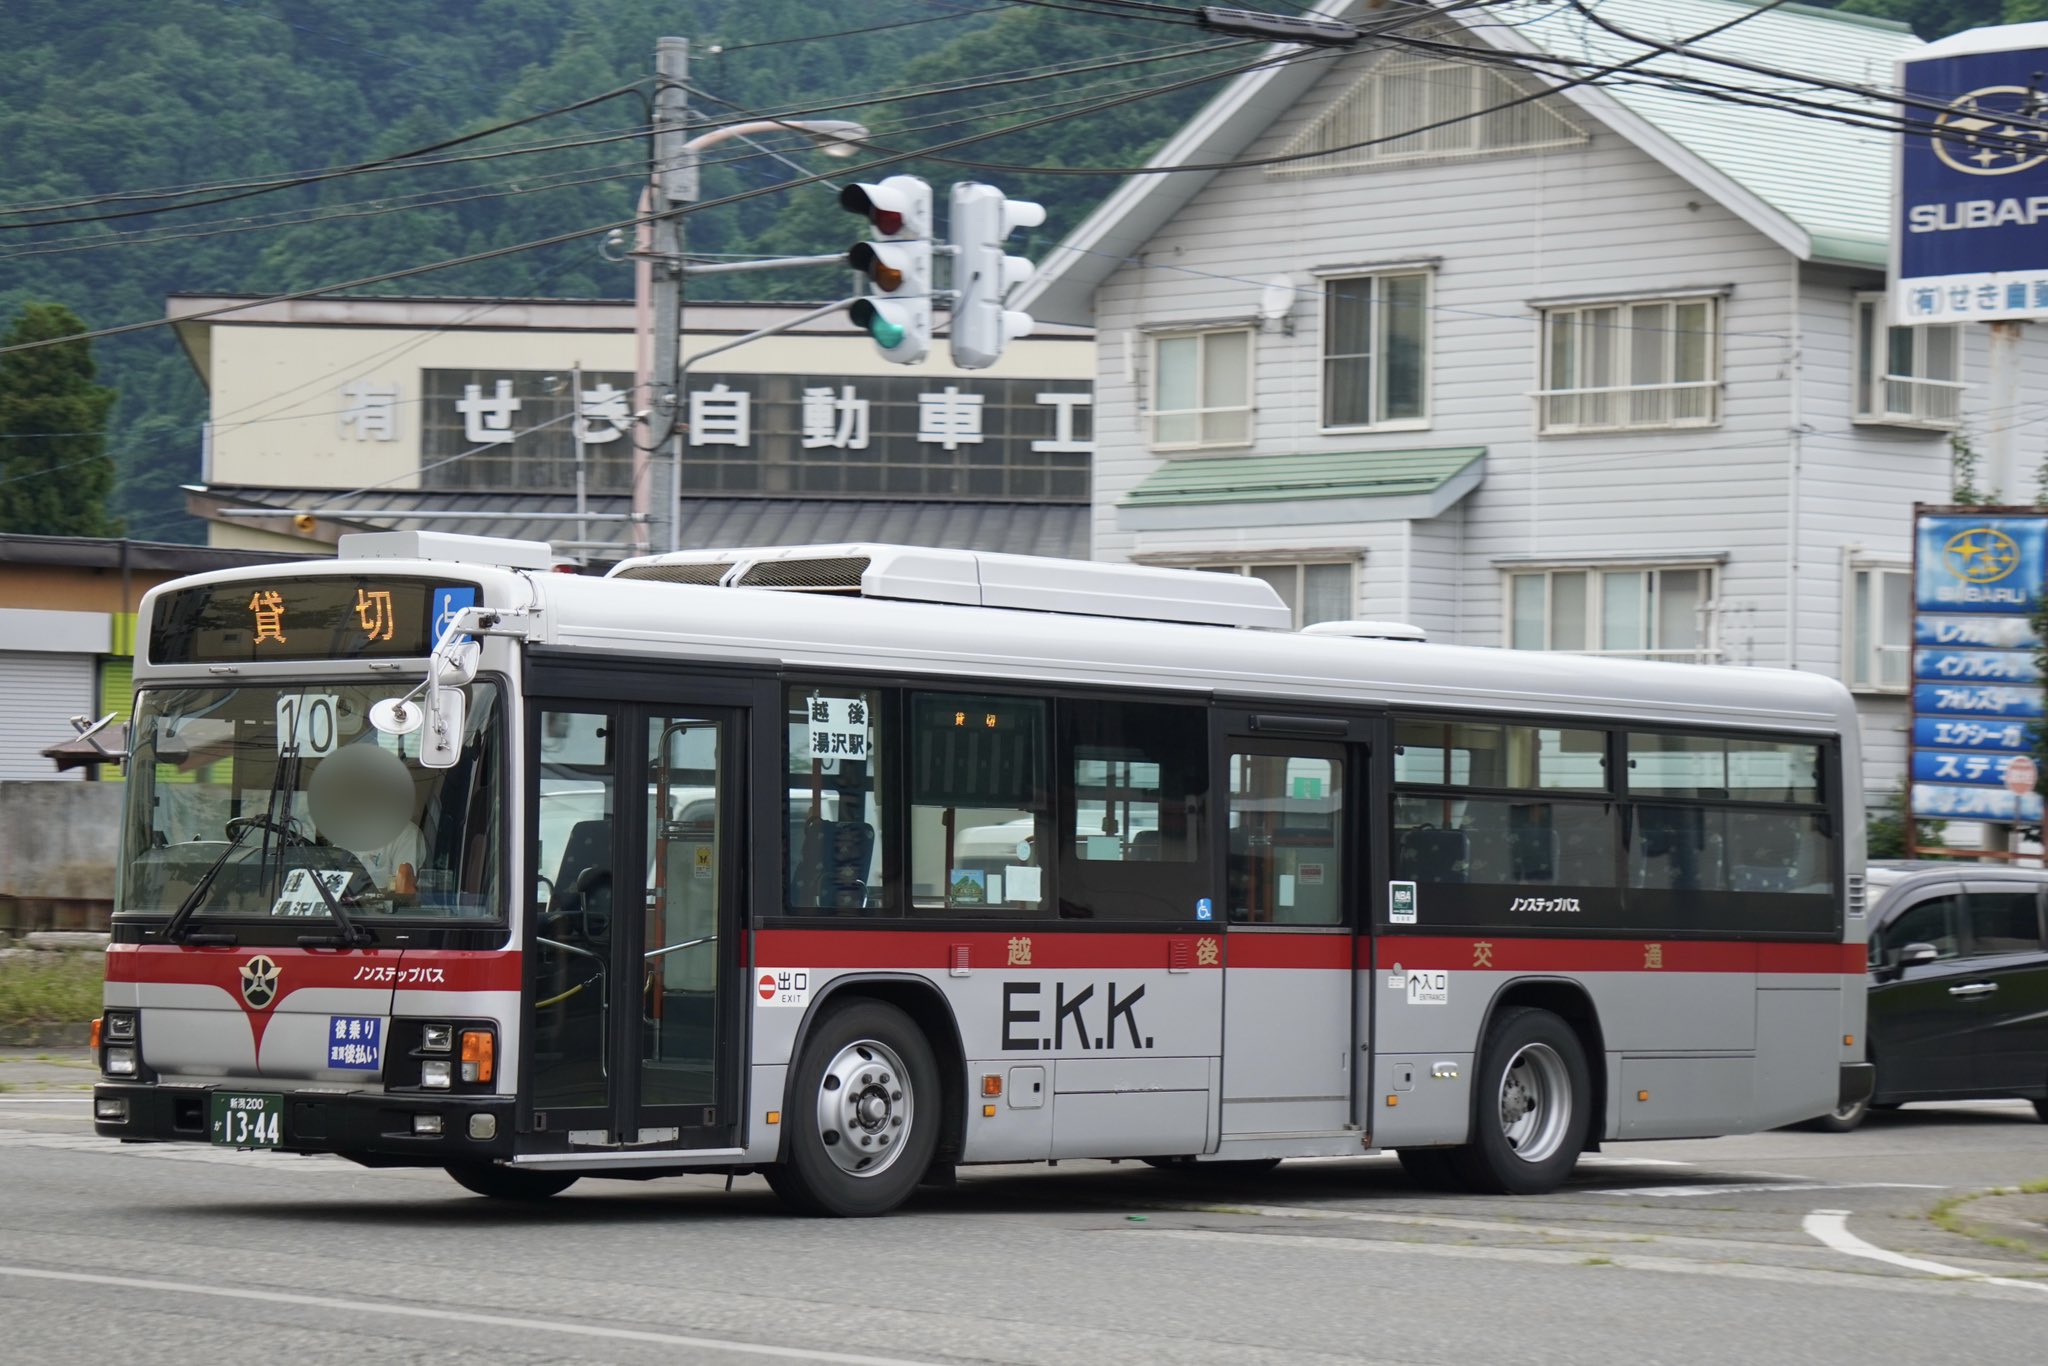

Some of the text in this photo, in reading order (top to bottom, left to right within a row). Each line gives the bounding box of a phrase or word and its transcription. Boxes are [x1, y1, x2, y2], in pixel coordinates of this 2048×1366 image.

[249, 588, 393, 644] 貸切
[812, 701, 865, 725] 越後
[282, 699, 333, 757] 10
[813, 731, 864, 755] 湯沢駅
[1510, 898, 1580, 912] ノンステップバス
[353, 966, 445, 982] ノンステップバス
[777, 971, 807, 990] 出口
[1421, 974, 1445, 990] 入口
[781, 994, 802, 1003] EXIT
[1419, 993, 1446, 1001] ENTRANCE
[1002, 982, 1154, 1050] E.K.K.
[335, 1019, 375, 1040] 後乗り
[225, 1111, 280, 1144] 13-44
